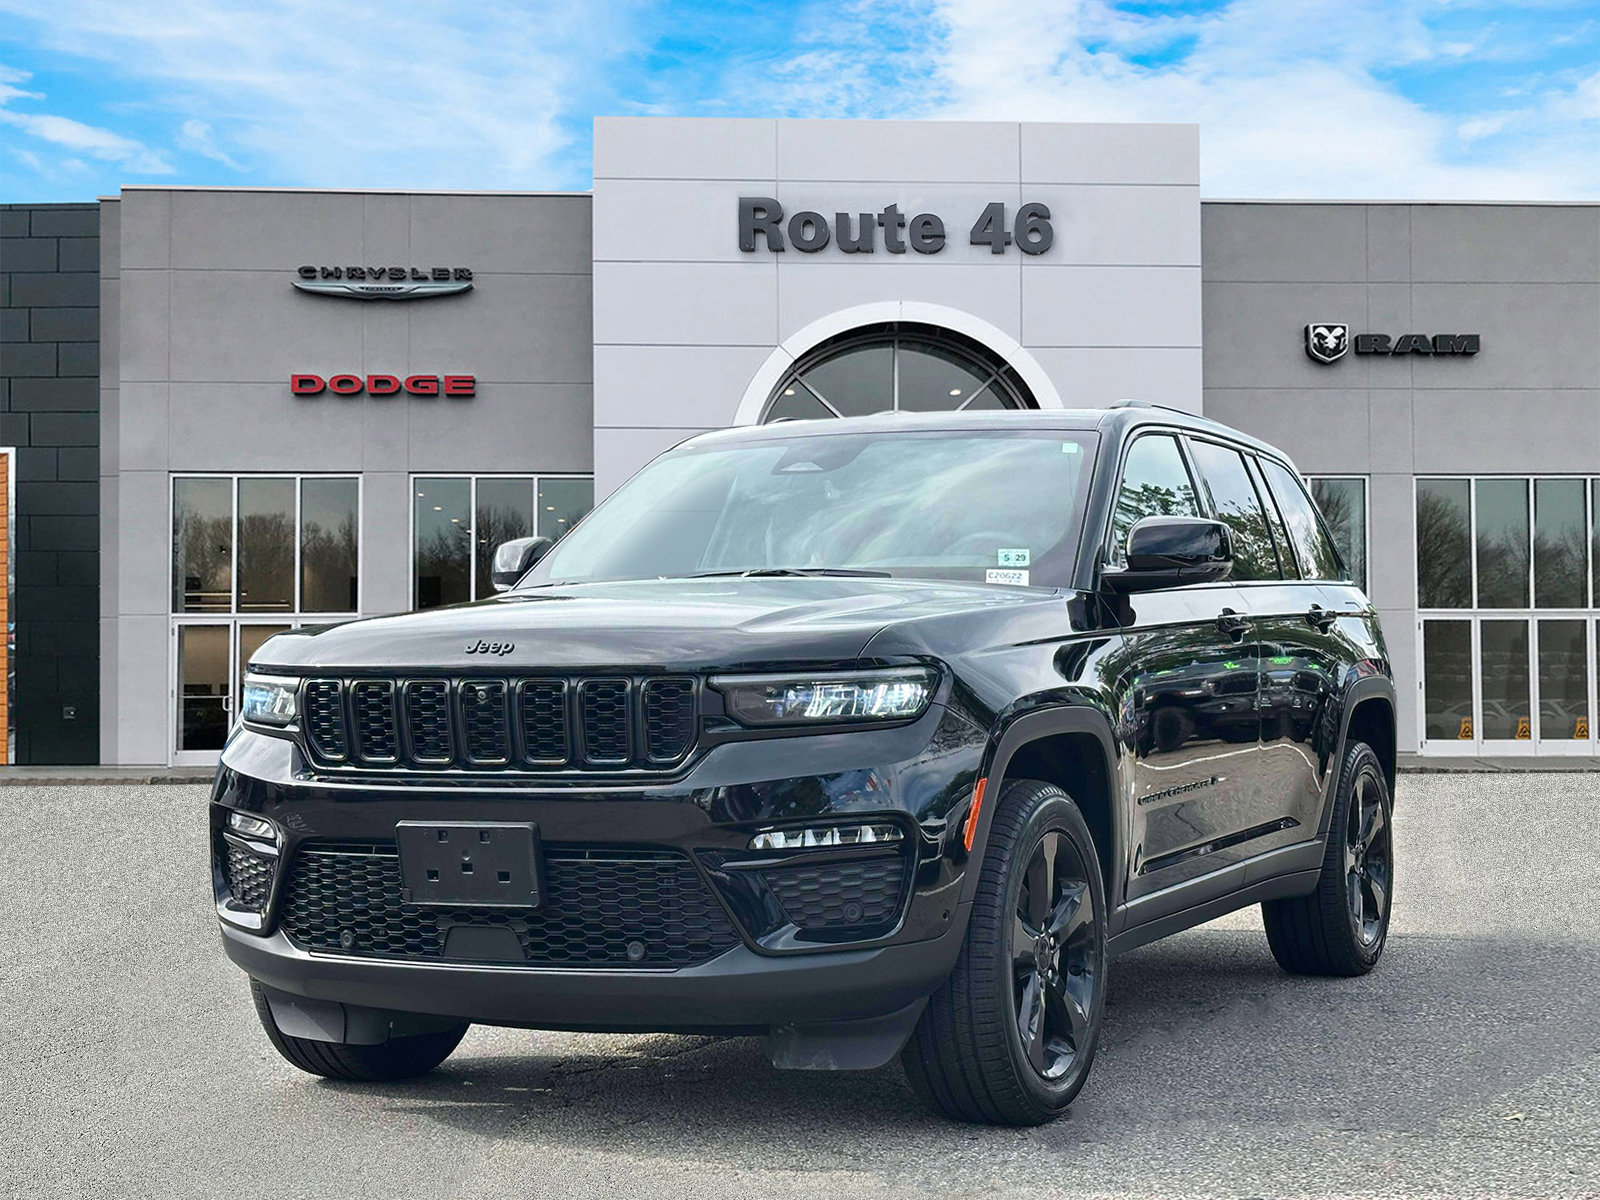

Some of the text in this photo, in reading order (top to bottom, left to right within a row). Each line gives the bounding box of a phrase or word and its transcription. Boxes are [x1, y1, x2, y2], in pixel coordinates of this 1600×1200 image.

[738, 197, 1054, 255] Route 46
[298, 266, 473, 281] CHRYSLER
[1354, 334, 1480, 357] RAM
[291, 374, 476, 397] DODGE
[465, 639, 515, 657] Jeep
